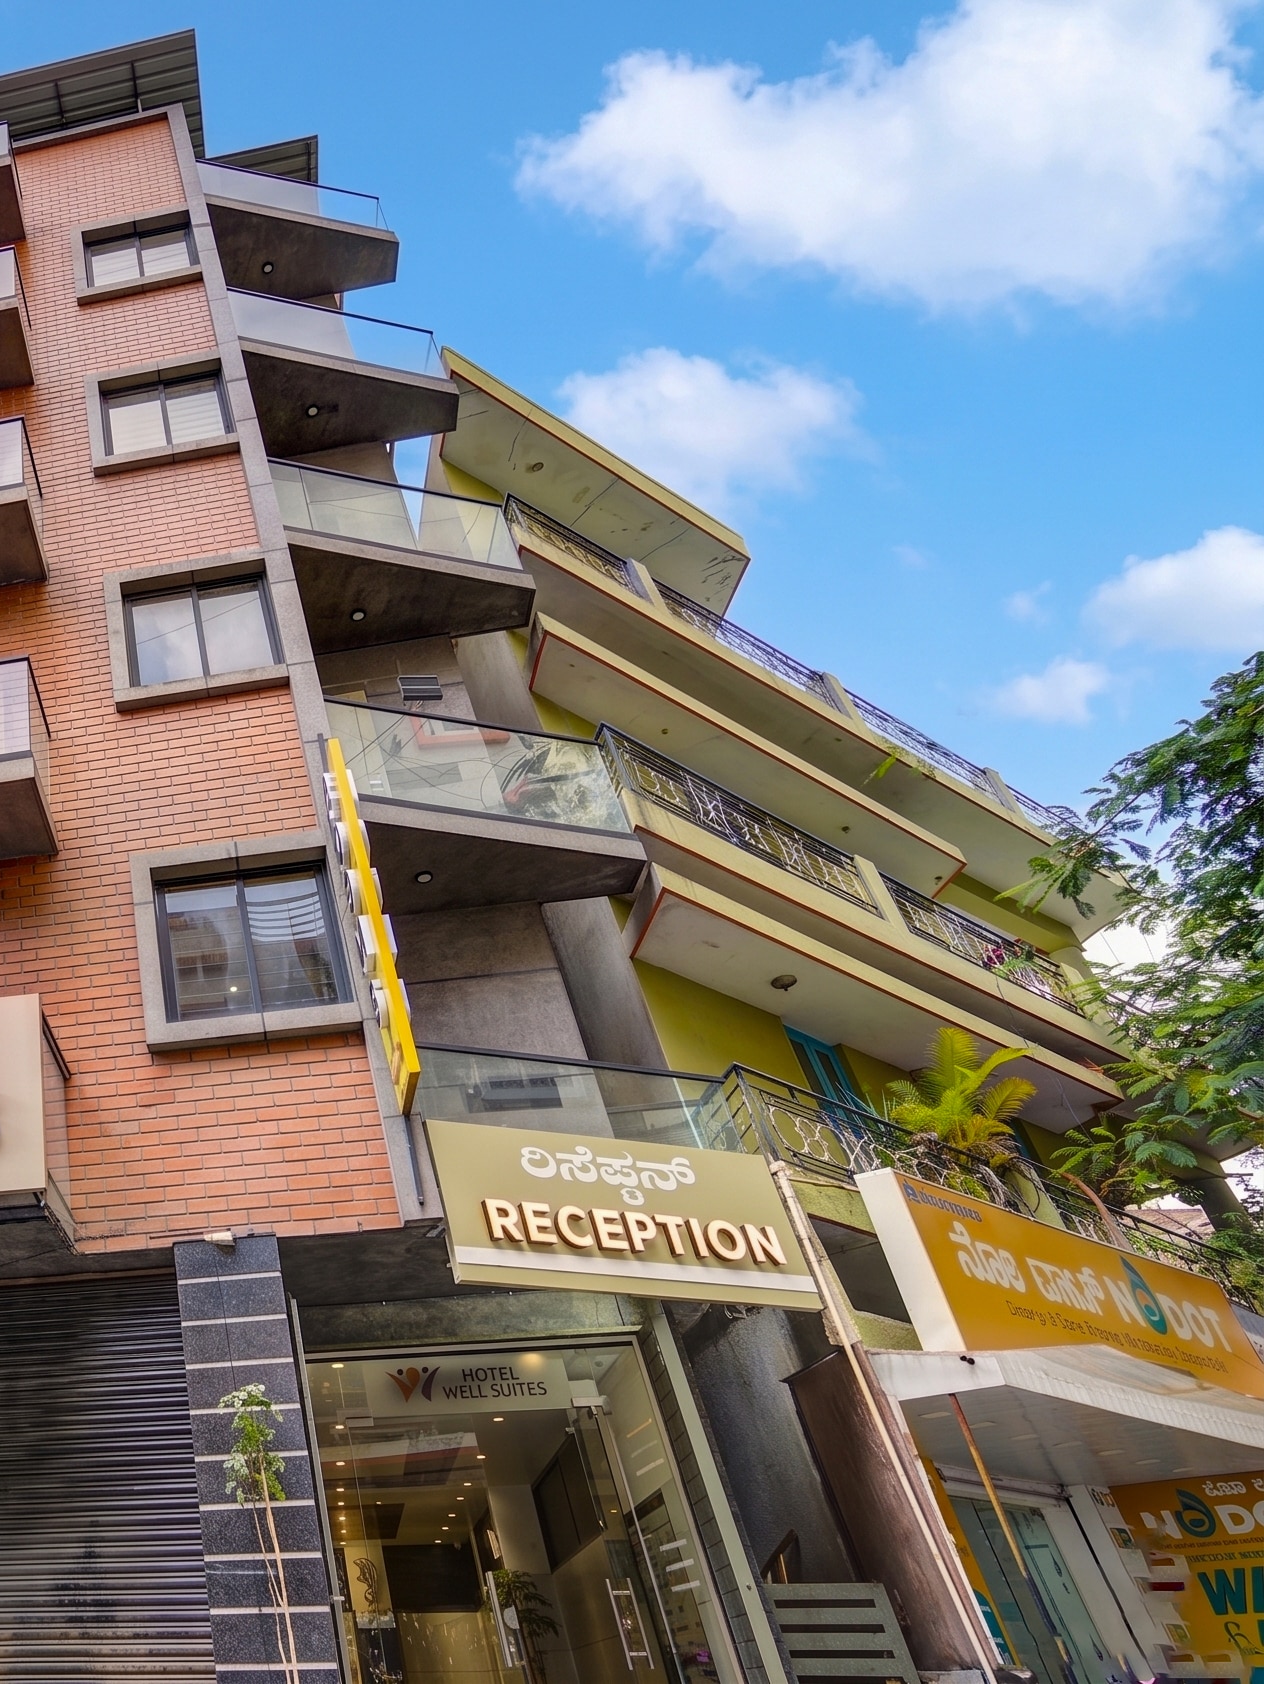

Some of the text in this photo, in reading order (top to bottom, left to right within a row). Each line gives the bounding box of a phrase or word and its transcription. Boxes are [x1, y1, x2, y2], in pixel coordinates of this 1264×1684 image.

[481, 1198, 788, 1266] RECEPTION
[462, 1366, 520, 1382] HOTEL
[442, 1381, 547, 1400] WELL SUITES
